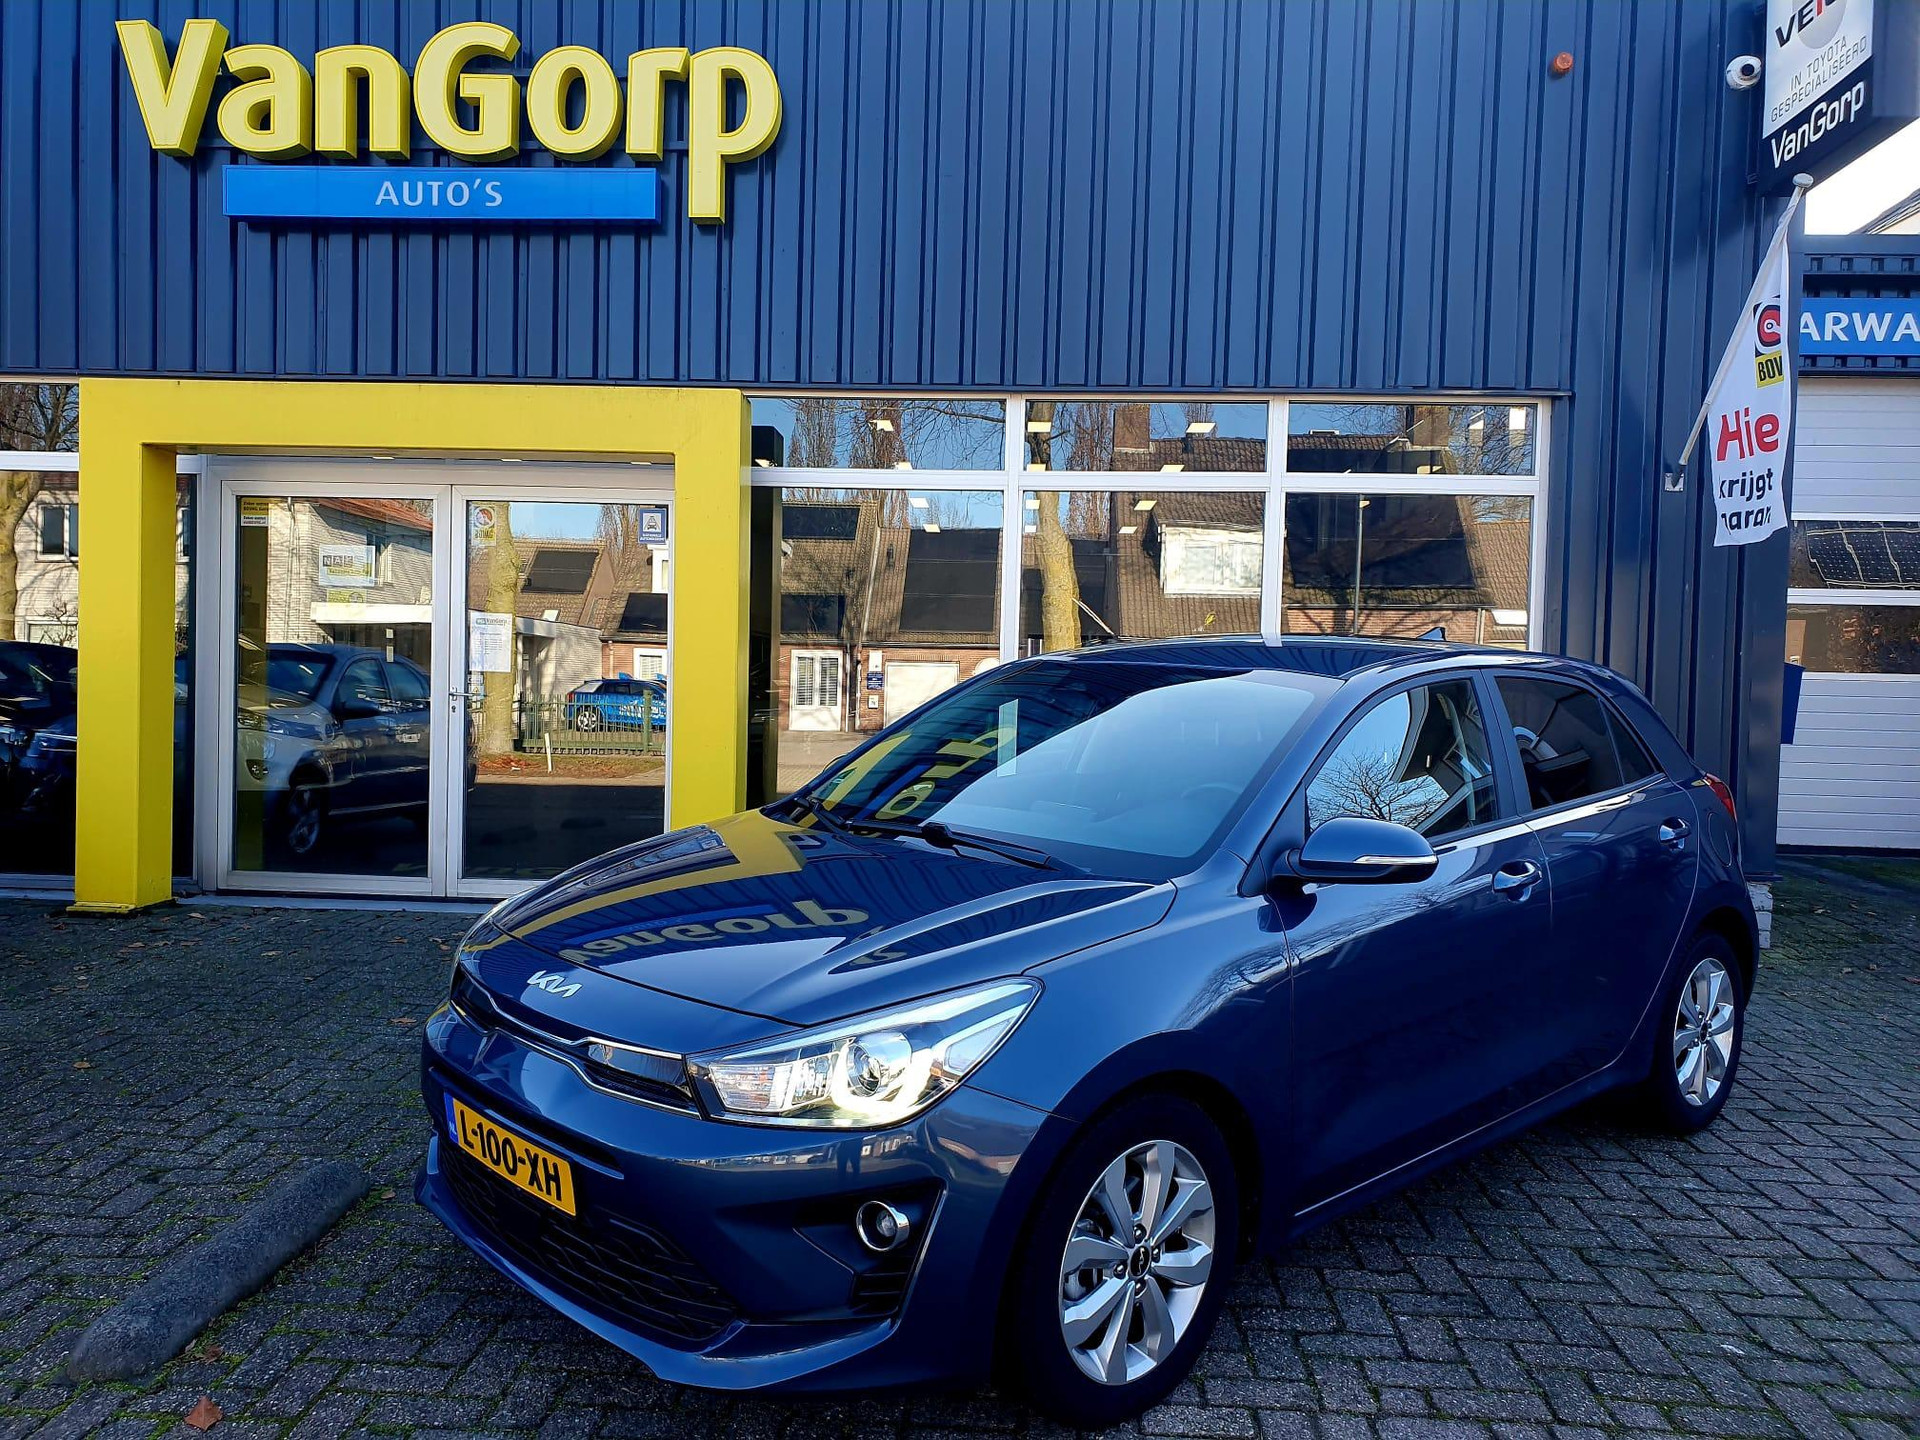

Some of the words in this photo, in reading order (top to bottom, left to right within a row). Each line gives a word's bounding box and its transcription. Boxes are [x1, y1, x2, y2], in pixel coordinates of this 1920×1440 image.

[1770, 36, 1867, 122] GESPECIALISEERD
[1790, 71, 1802, 92] IN
[1806, 35, 1847, 74] TOYOTA
[115, 19, 782, 225] VanGorp
[1771, 81, 1865, 169] VanGorp
[374, 178, 503, 208] AUTO'S
[526, 969, 583, 998] KIA
[460, 1109, 562, 1202] L-100-XH
